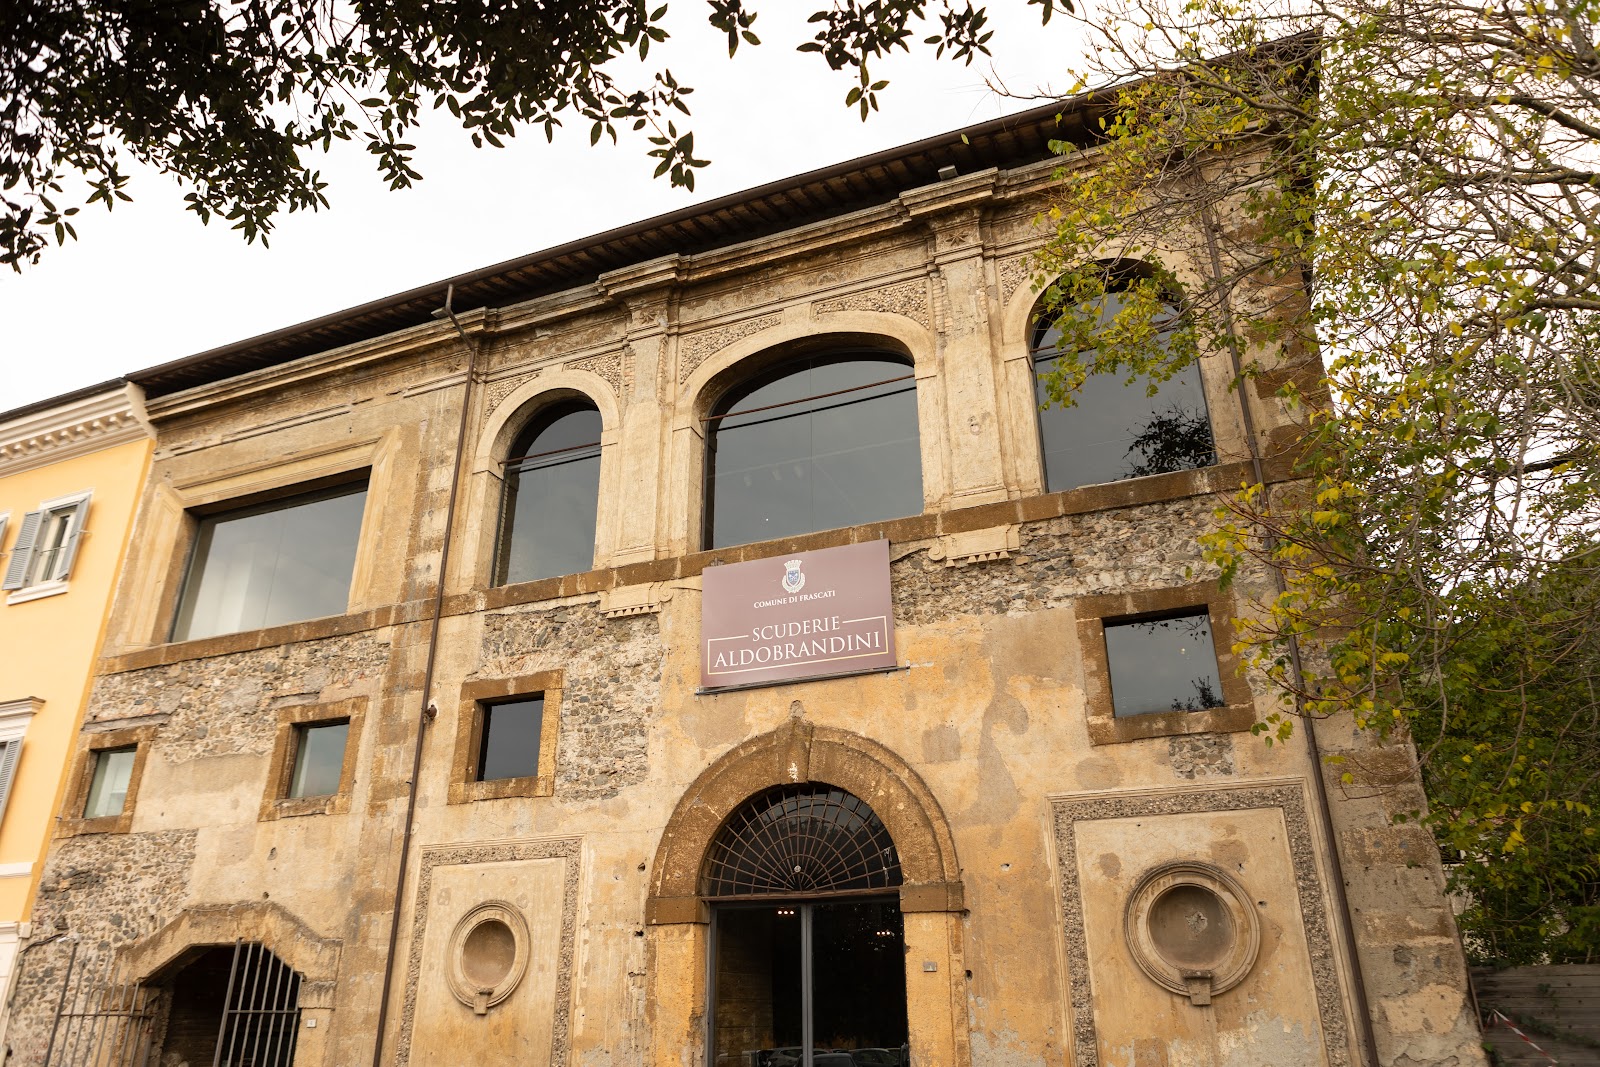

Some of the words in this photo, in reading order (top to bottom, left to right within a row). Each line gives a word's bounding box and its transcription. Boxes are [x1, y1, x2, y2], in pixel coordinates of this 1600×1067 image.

[753, 597, 788, 609] COMUNE
[788, 596, 798, 604] DI
[799, 590, 836, 602] FRASCATI
[752, 616, 841, 642] SCUDERIE
[713, 631, 881, 668] ALDOBRANDINI
